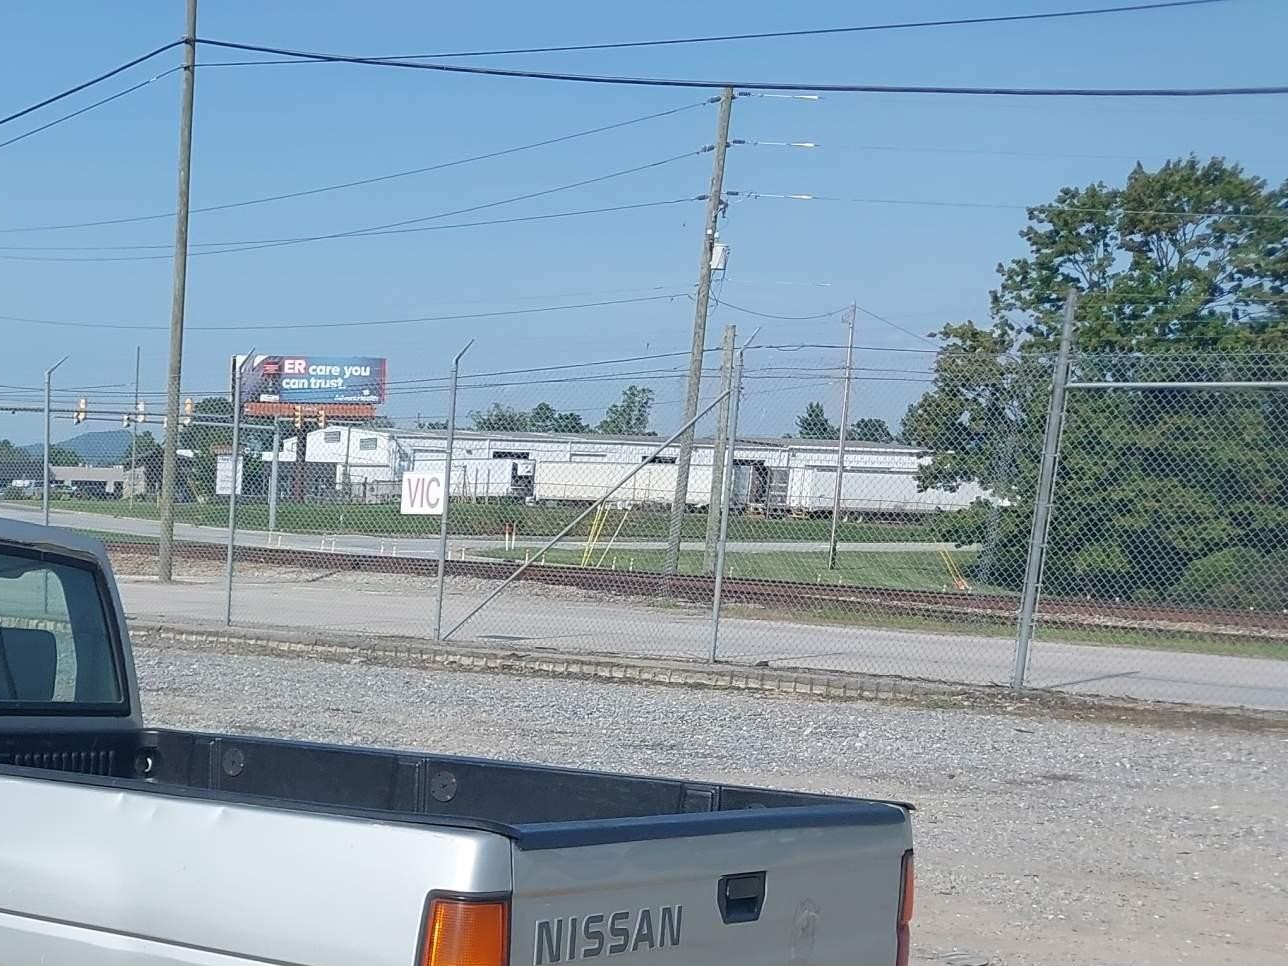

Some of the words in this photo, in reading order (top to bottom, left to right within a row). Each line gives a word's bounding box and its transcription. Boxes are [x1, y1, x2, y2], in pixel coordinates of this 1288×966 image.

[283, 359, 306, 374] ER
[309, 364, 340, 376] care
[344, 365, 371, 380] you
[282, 379, 308, 389] can
[407, 476, 441, 509] VIC
[533, 904, 683, 966] NISSAN
